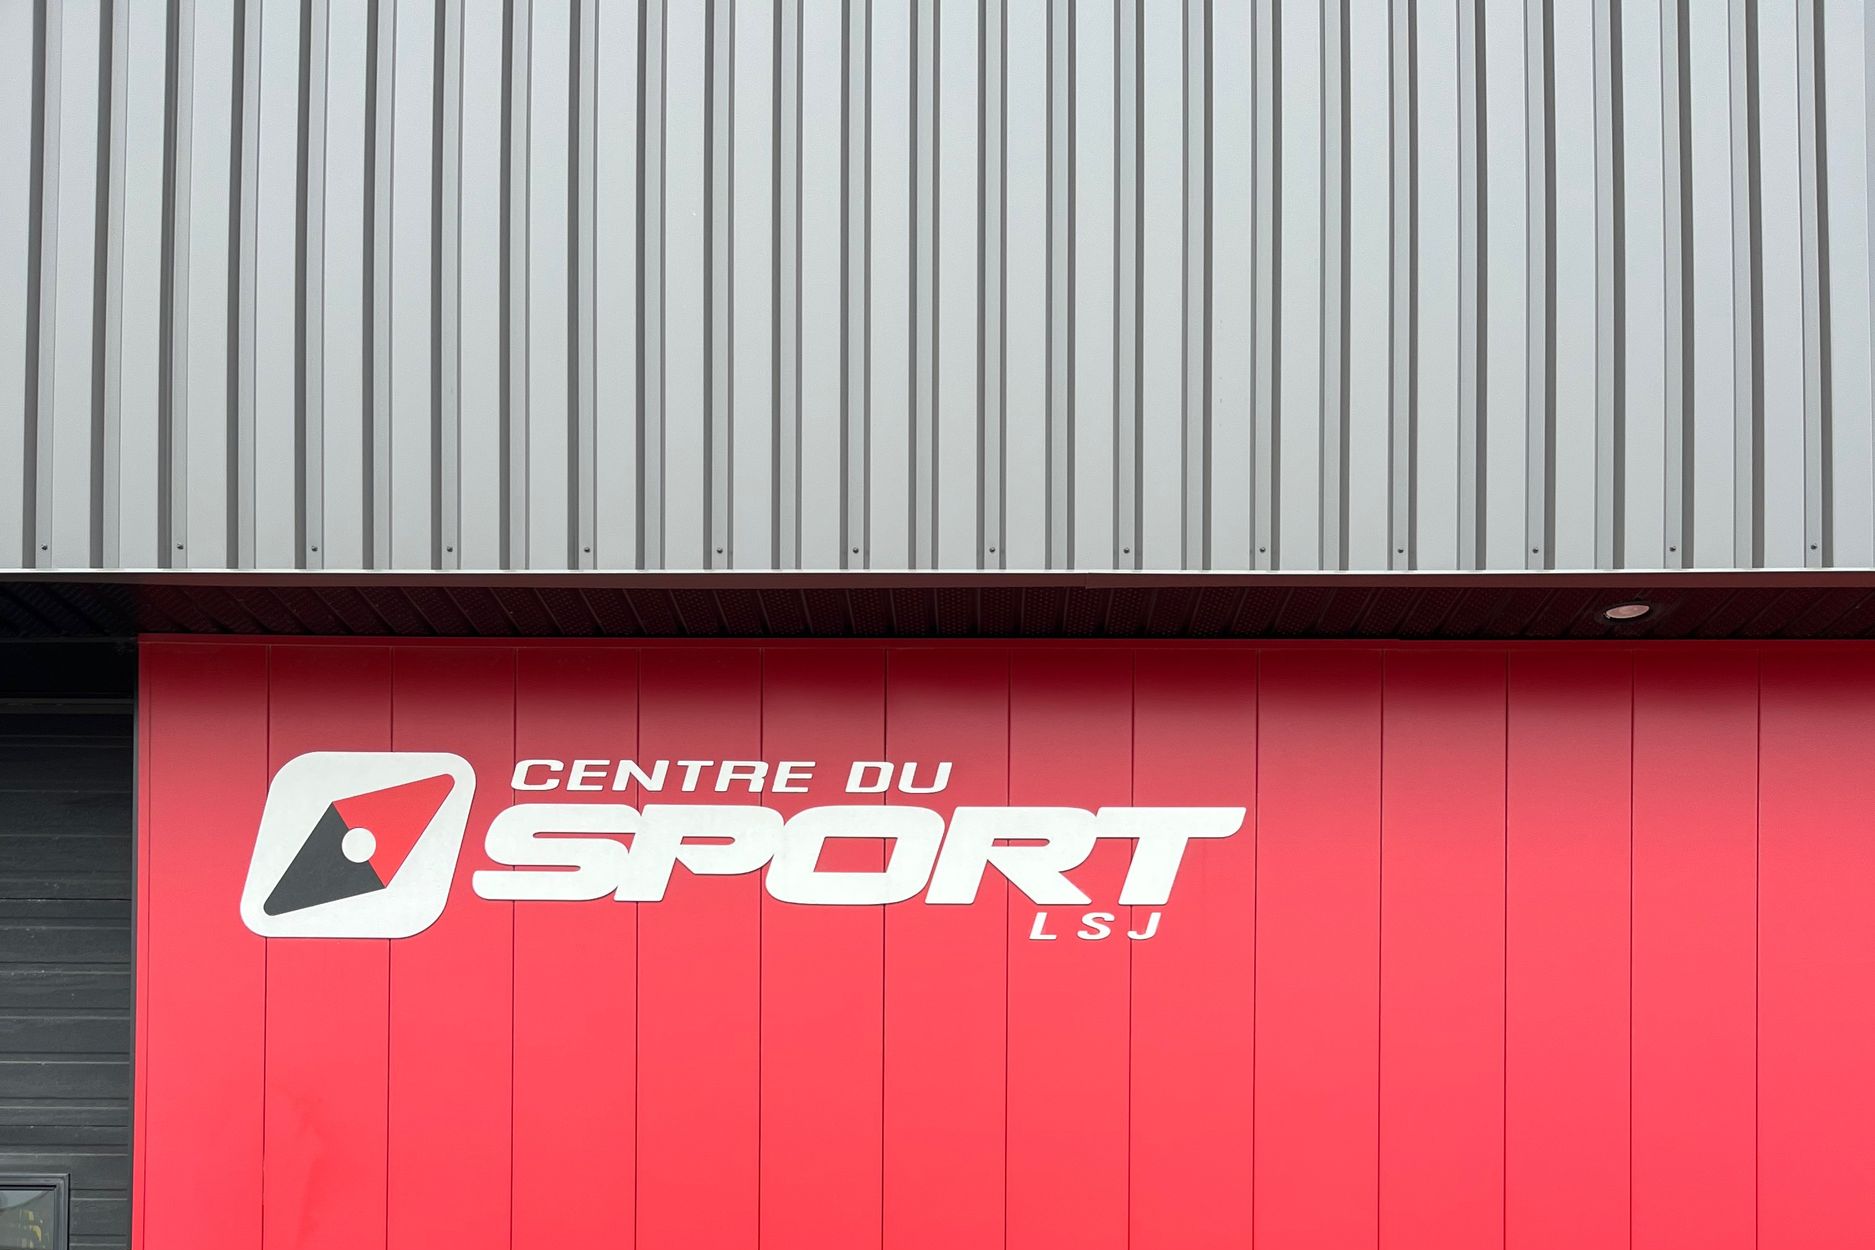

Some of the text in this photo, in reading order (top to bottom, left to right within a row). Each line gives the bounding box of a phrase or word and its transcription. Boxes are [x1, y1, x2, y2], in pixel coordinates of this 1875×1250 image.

[510, 758, 953, 794] CENTRE DU
[471, 802, 1247, 905] SPORT
[1029, 910, 1162, 941] LSJ
